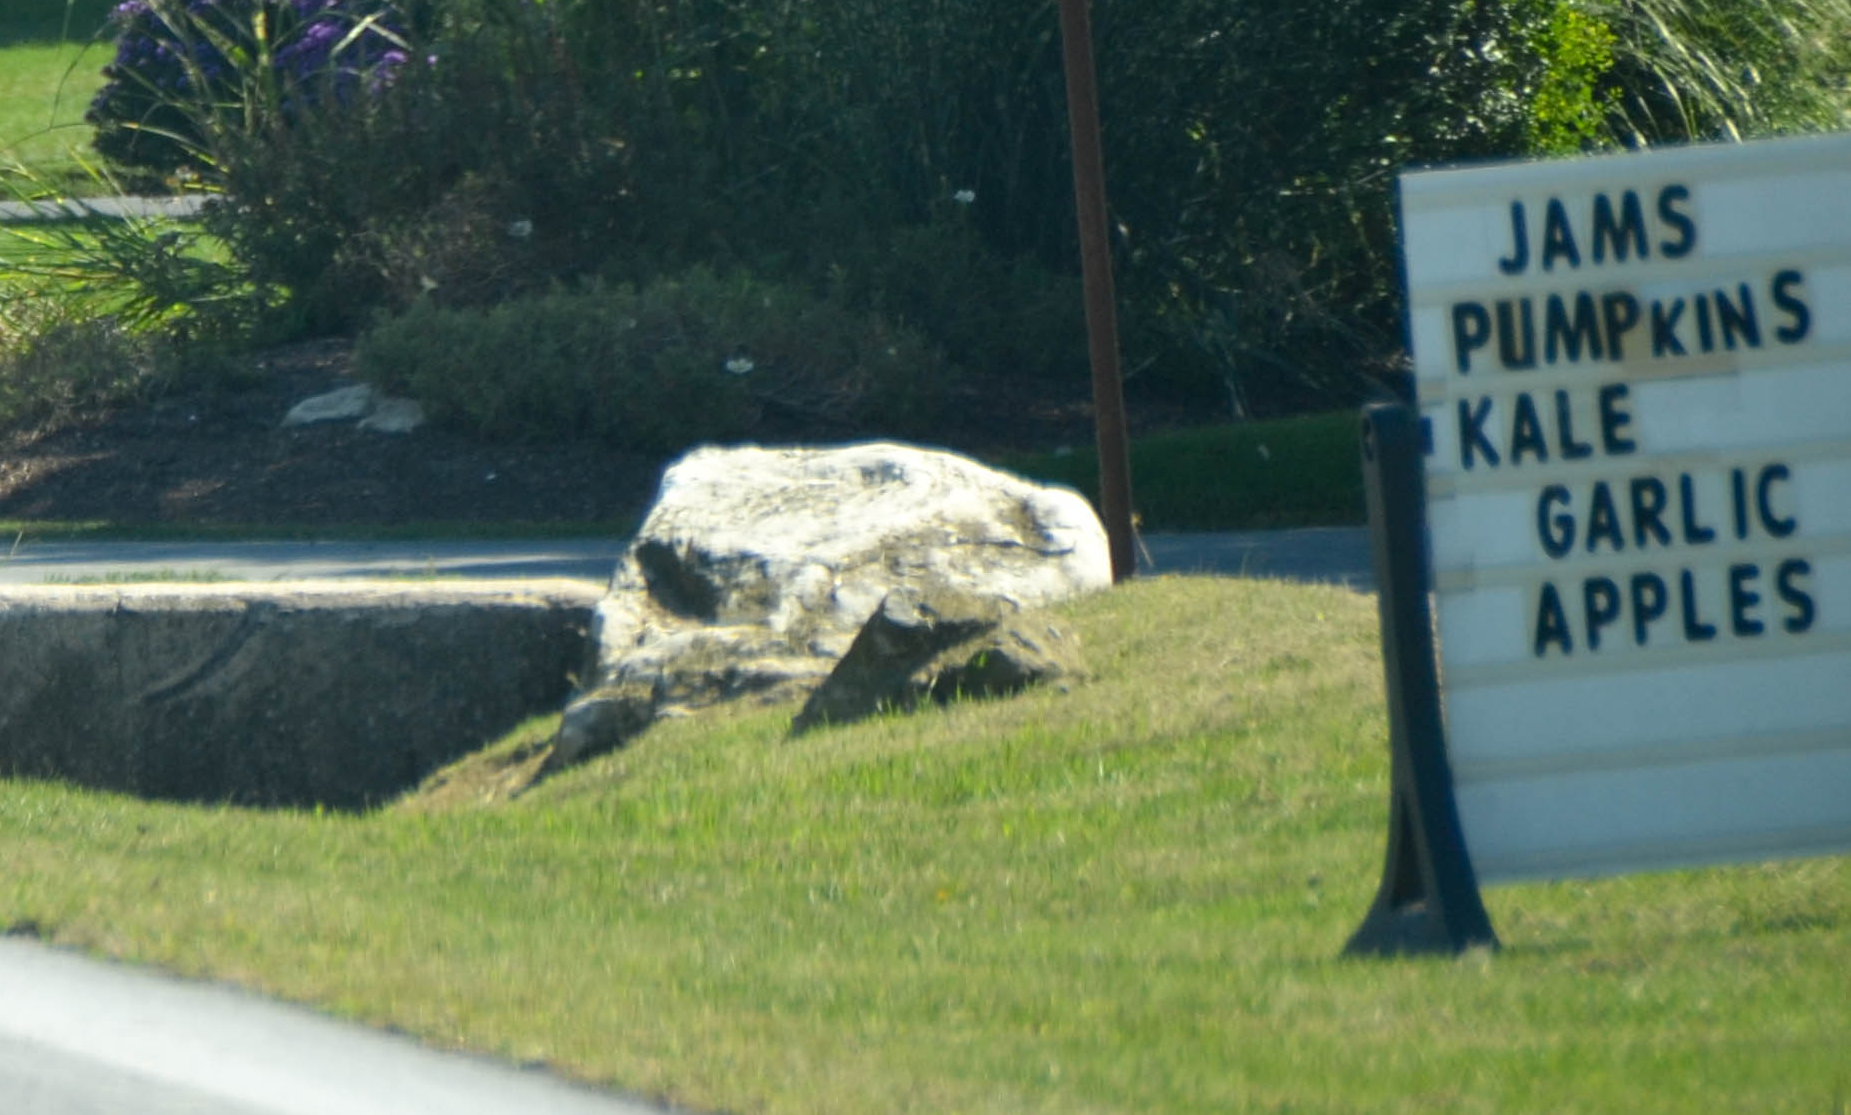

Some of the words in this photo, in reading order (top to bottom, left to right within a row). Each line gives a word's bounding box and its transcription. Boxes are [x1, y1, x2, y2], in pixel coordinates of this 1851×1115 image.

[1498, 185, 1697, 275] JAMS
[1452, 269, 1811, 375] PUMPKINS
[1457, 384, 1637, 471] KALE
[1536, 464, 1798, 559] GARLIC
[1534, 558, 1816, 658] APPLES
